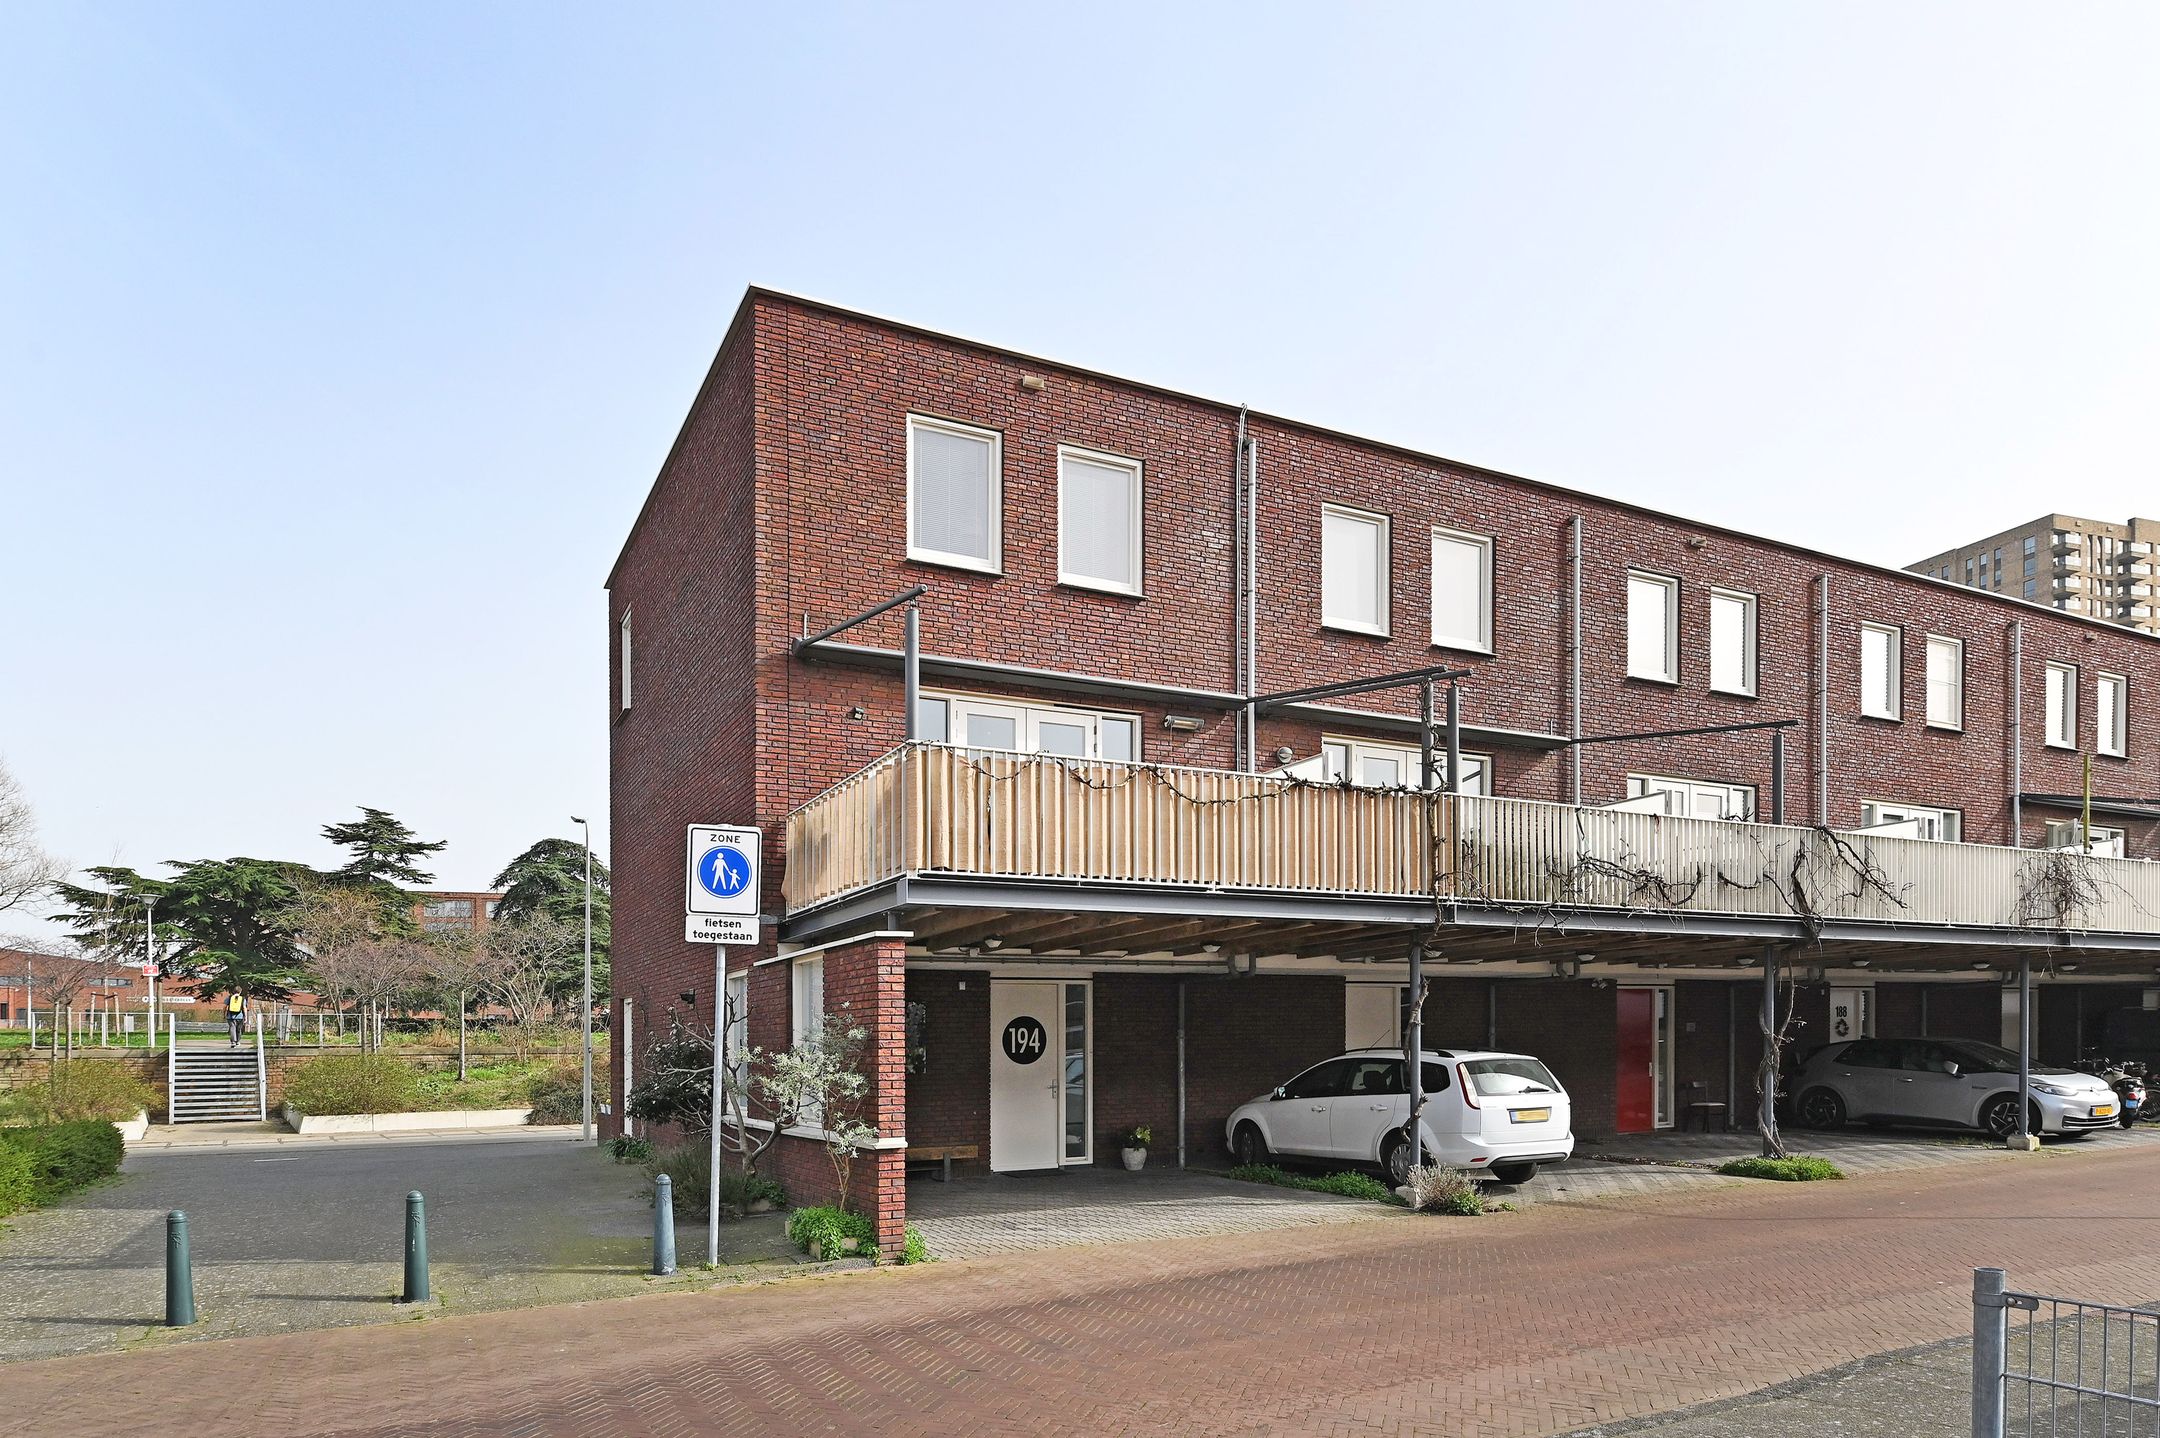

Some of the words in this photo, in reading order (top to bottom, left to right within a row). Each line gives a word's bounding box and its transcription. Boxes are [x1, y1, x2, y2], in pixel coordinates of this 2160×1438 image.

[710, 834, 741, 844] ZONE
[705, 918, 742, 928] fietsen
[693, 930, 752, 941] toegestaan
[1835, 1005, 1848, 1018] 188
[1009, 1027, 1040, 1054] 194
